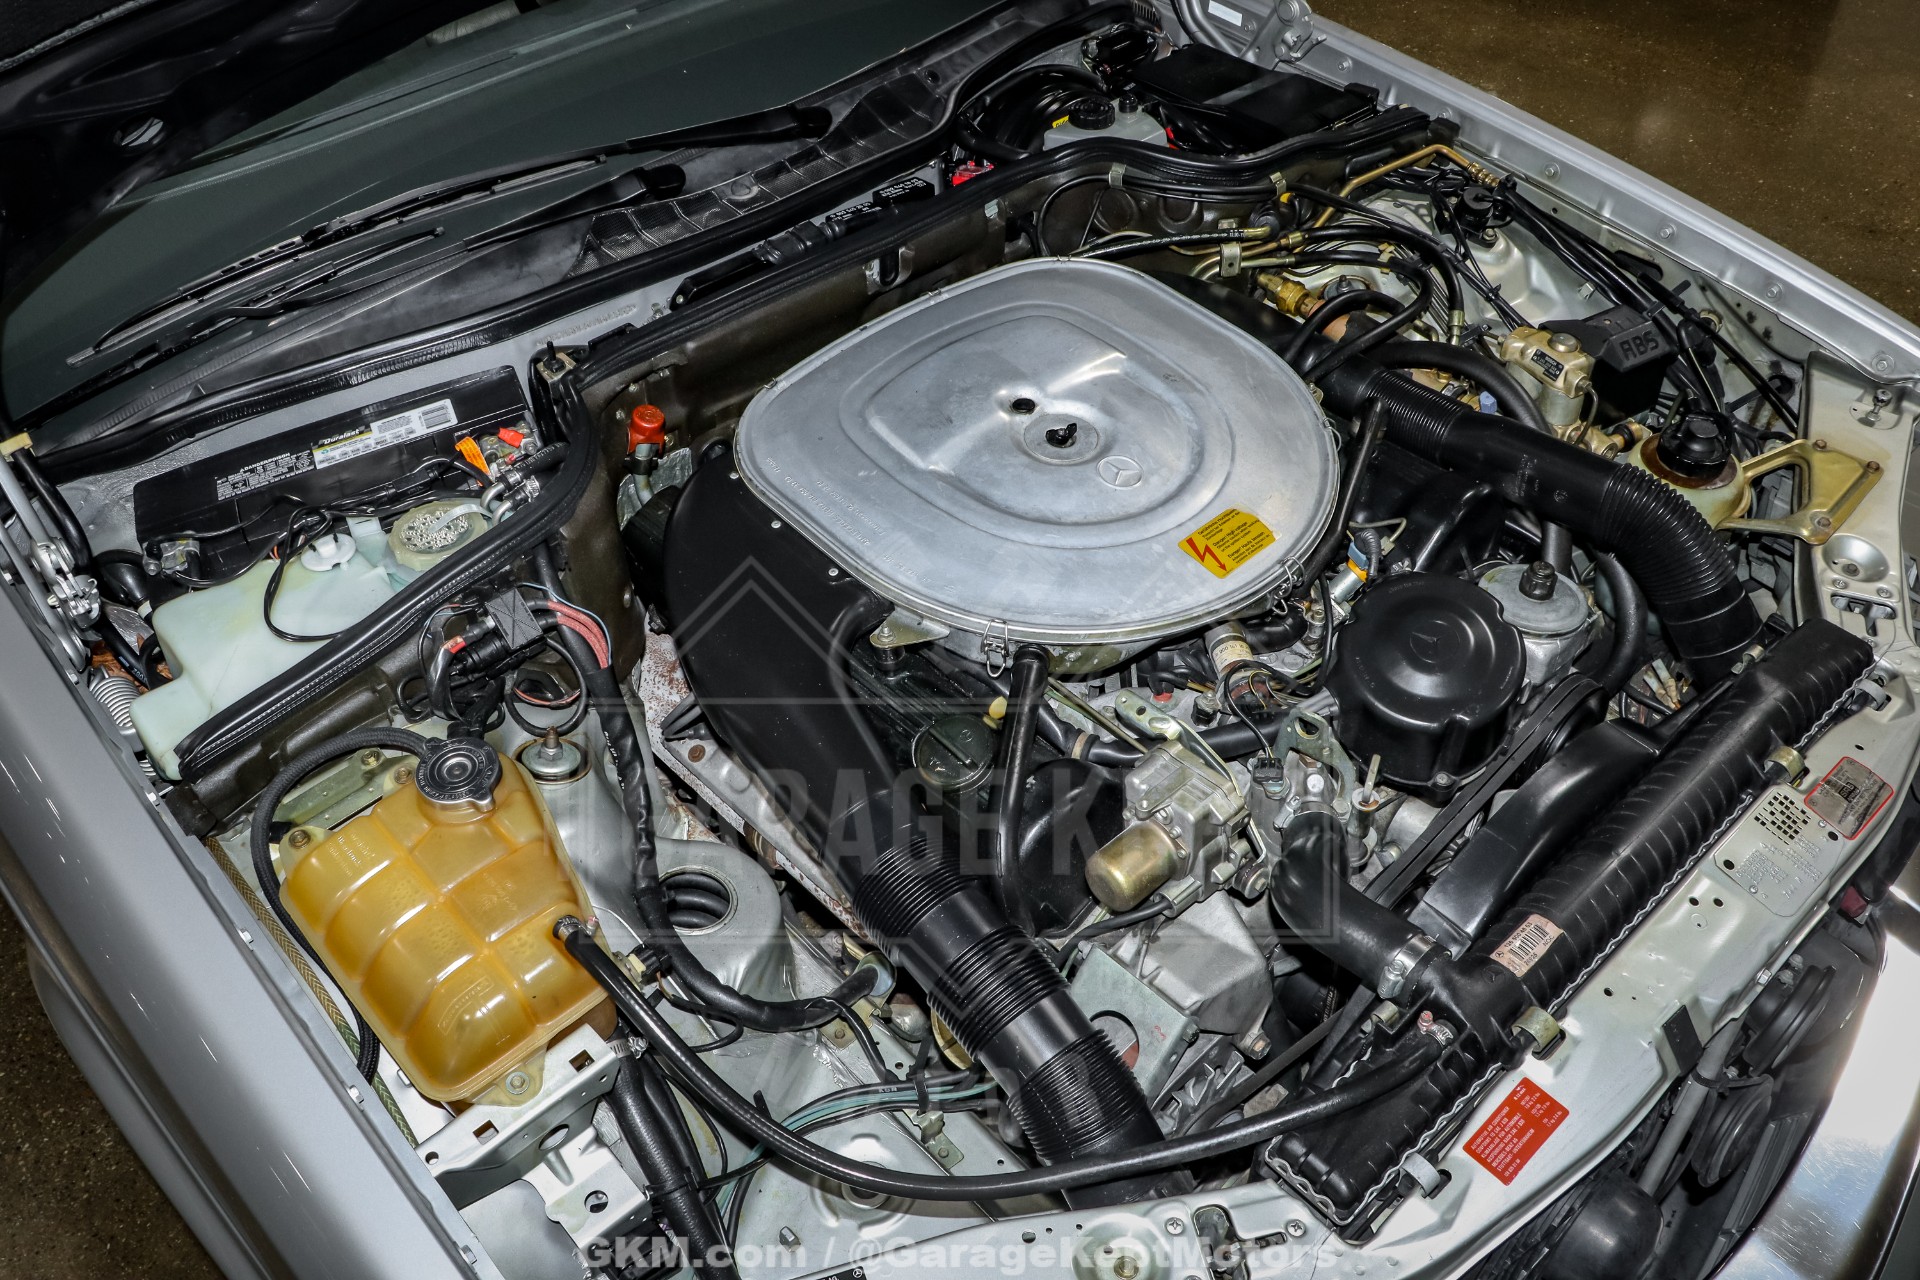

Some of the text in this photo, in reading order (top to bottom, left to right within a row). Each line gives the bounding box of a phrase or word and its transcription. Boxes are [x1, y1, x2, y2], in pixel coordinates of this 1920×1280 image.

[1619, 331, 1659, 361] ABS
[323, 429, 360, 444] Duralast
[1470, 1130, 1489, 1150] AUTOMOTIVE
[1491, 1106, 1510, 1126] CONDITIONER
[1491, 1142, 1515, 1168] MERCEDES-BENZ
